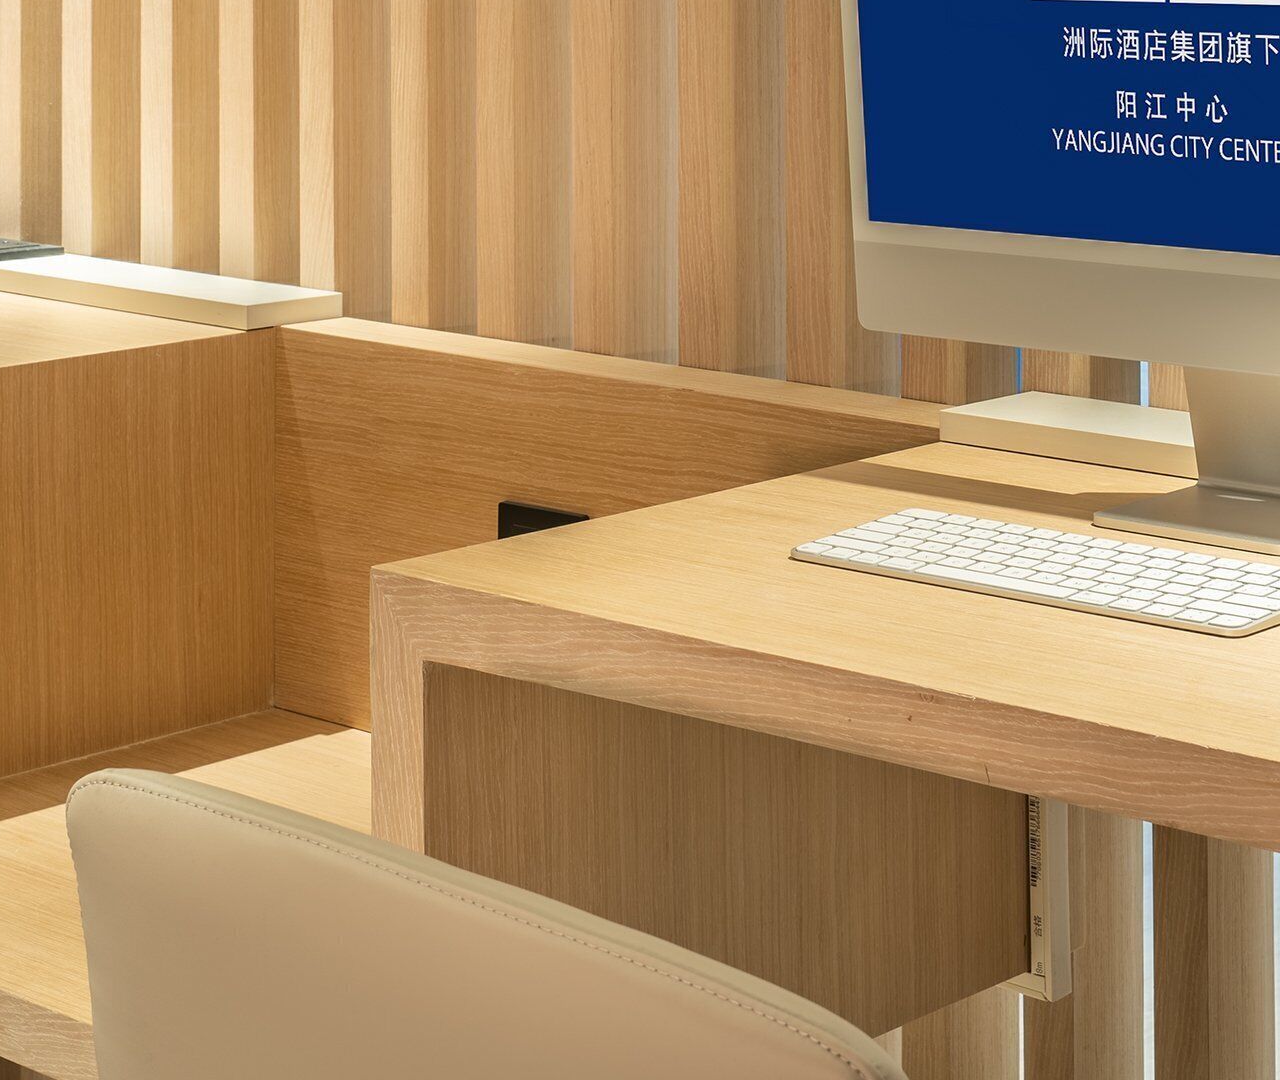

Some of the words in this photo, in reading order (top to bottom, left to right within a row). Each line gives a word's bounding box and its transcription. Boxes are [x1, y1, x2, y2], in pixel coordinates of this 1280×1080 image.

[1063, 26, 1280, 66] 洲际酒店集团旗下
[1115, 89, 1229, 124] 阳江中心
[1051, 128, 1166, 157] YANGJIANG
[1170, 134, 1214, 160] CITY
